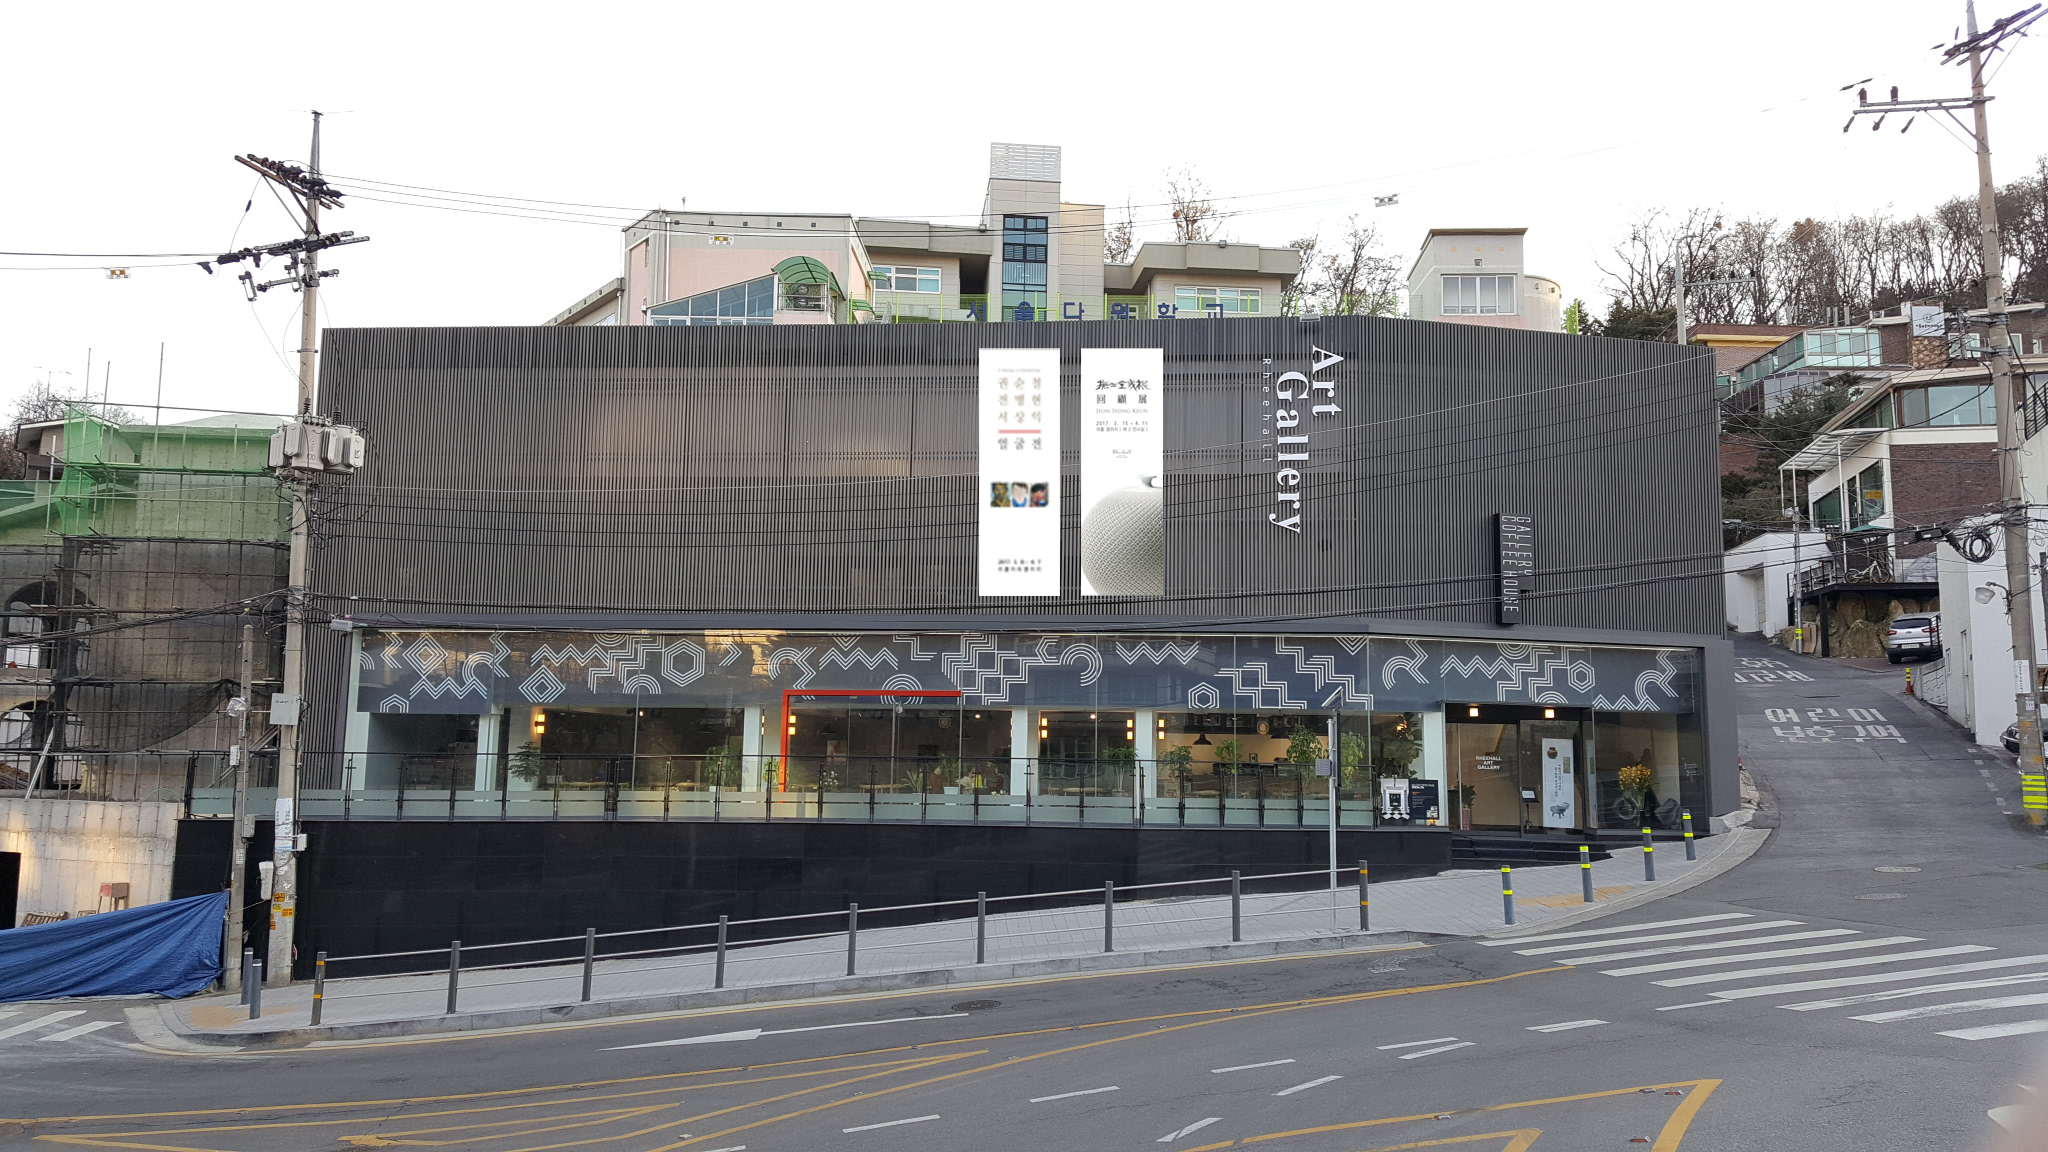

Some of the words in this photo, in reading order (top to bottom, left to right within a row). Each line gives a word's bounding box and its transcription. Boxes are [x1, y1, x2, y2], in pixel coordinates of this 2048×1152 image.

[1312, 345, 1345, 417] Art
[1262, 358, 1272, 463] Rheehall
[1269, 371, 1309, 534] Gallery
[1502, 515, 1517, 566] COFFEE
[1516, 516, 1533, 576] GALLERY
[1503, 570, 1519, 612] HOUSE
[1764, 707, 1888, 723] 어린이
[1772, 724, 1907, 744] 보호구역
